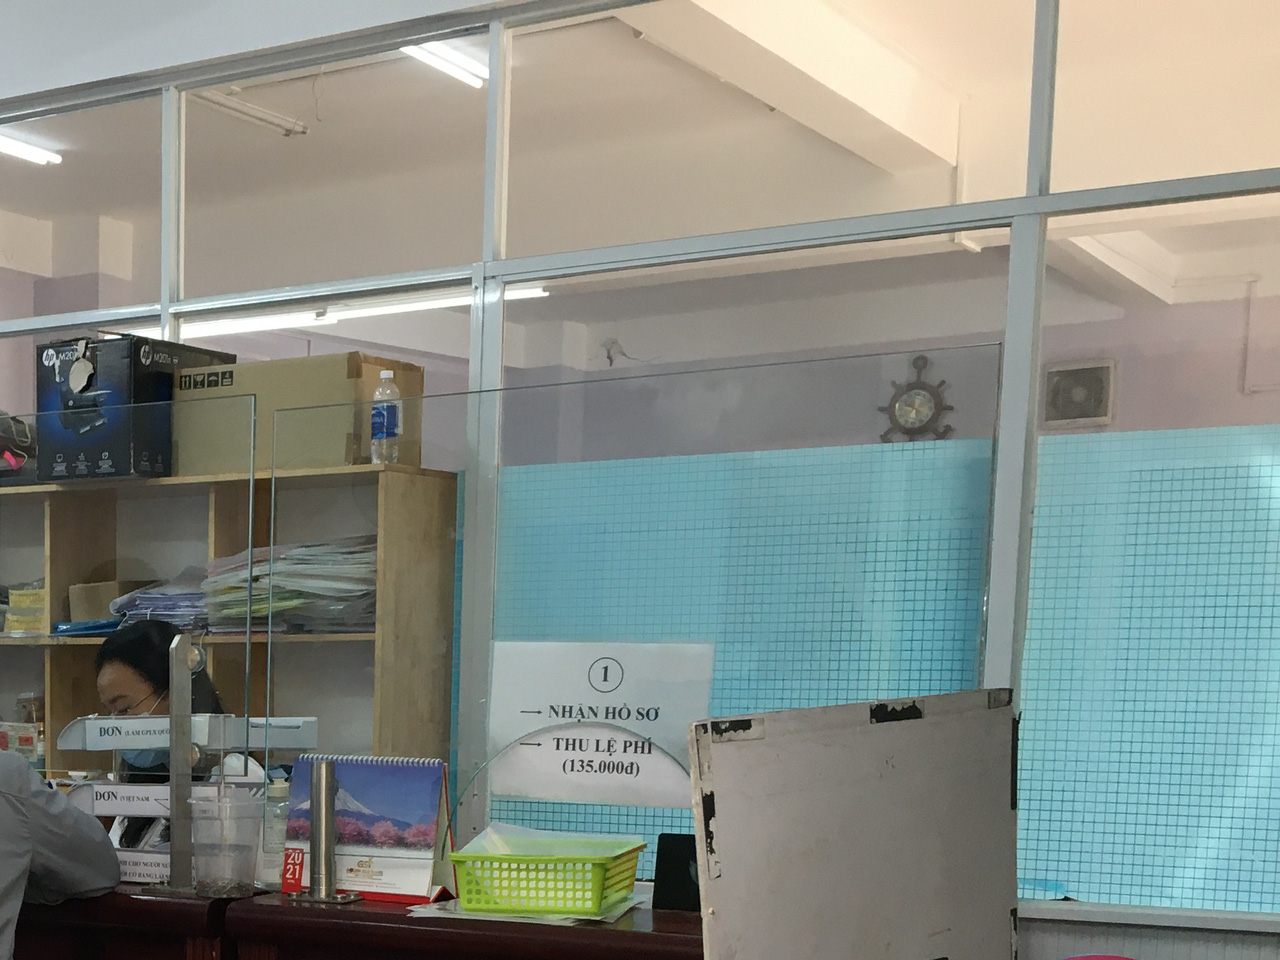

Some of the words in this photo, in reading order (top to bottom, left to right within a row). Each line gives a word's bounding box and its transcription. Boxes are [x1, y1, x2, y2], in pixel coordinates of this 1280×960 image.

[43, 350, 55, 366] hp
[141, 346, 152, 365] hp
[601, 666, 609, 682] 1
[548, 704, 599, 722] NHẬN
[604, 703, 631, 721] HỒ
[635, 707, 660, 722] SƠ
[99, 726, 122, 737] ĐƠN
[553, 738, 589, 752] THU
[594, 737, 617, 756] LỆ
[622, 737, 652, 754] PHÍ
[562, 759, 640, 777] (135.000đ)
[287, 850, 302, 864] 20
[286, 865, 300, 879] 21
